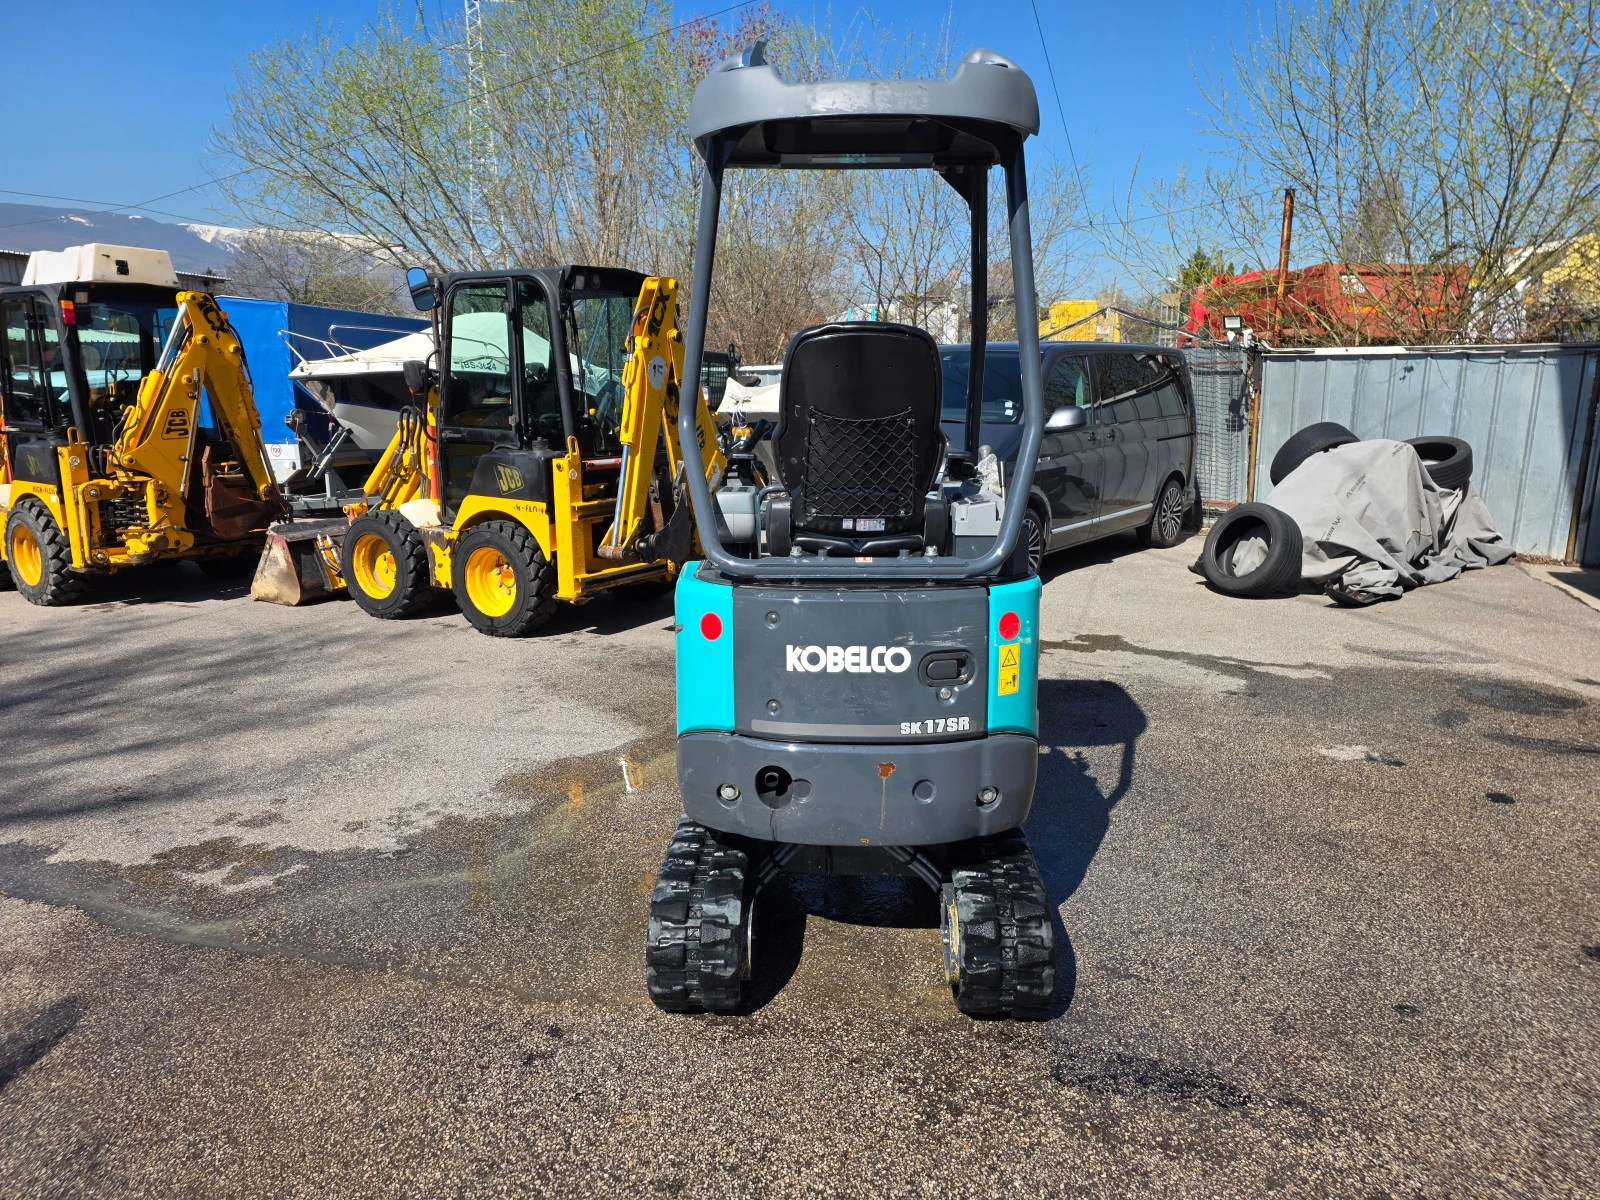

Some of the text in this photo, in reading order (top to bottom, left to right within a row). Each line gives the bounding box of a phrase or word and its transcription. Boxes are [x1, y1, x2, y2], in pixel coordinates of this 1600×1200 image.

[165, 410, 189, 436] JCB
[497, 465, 522, 491] JCB
[785, 644, 912, 673] KOBELCO
